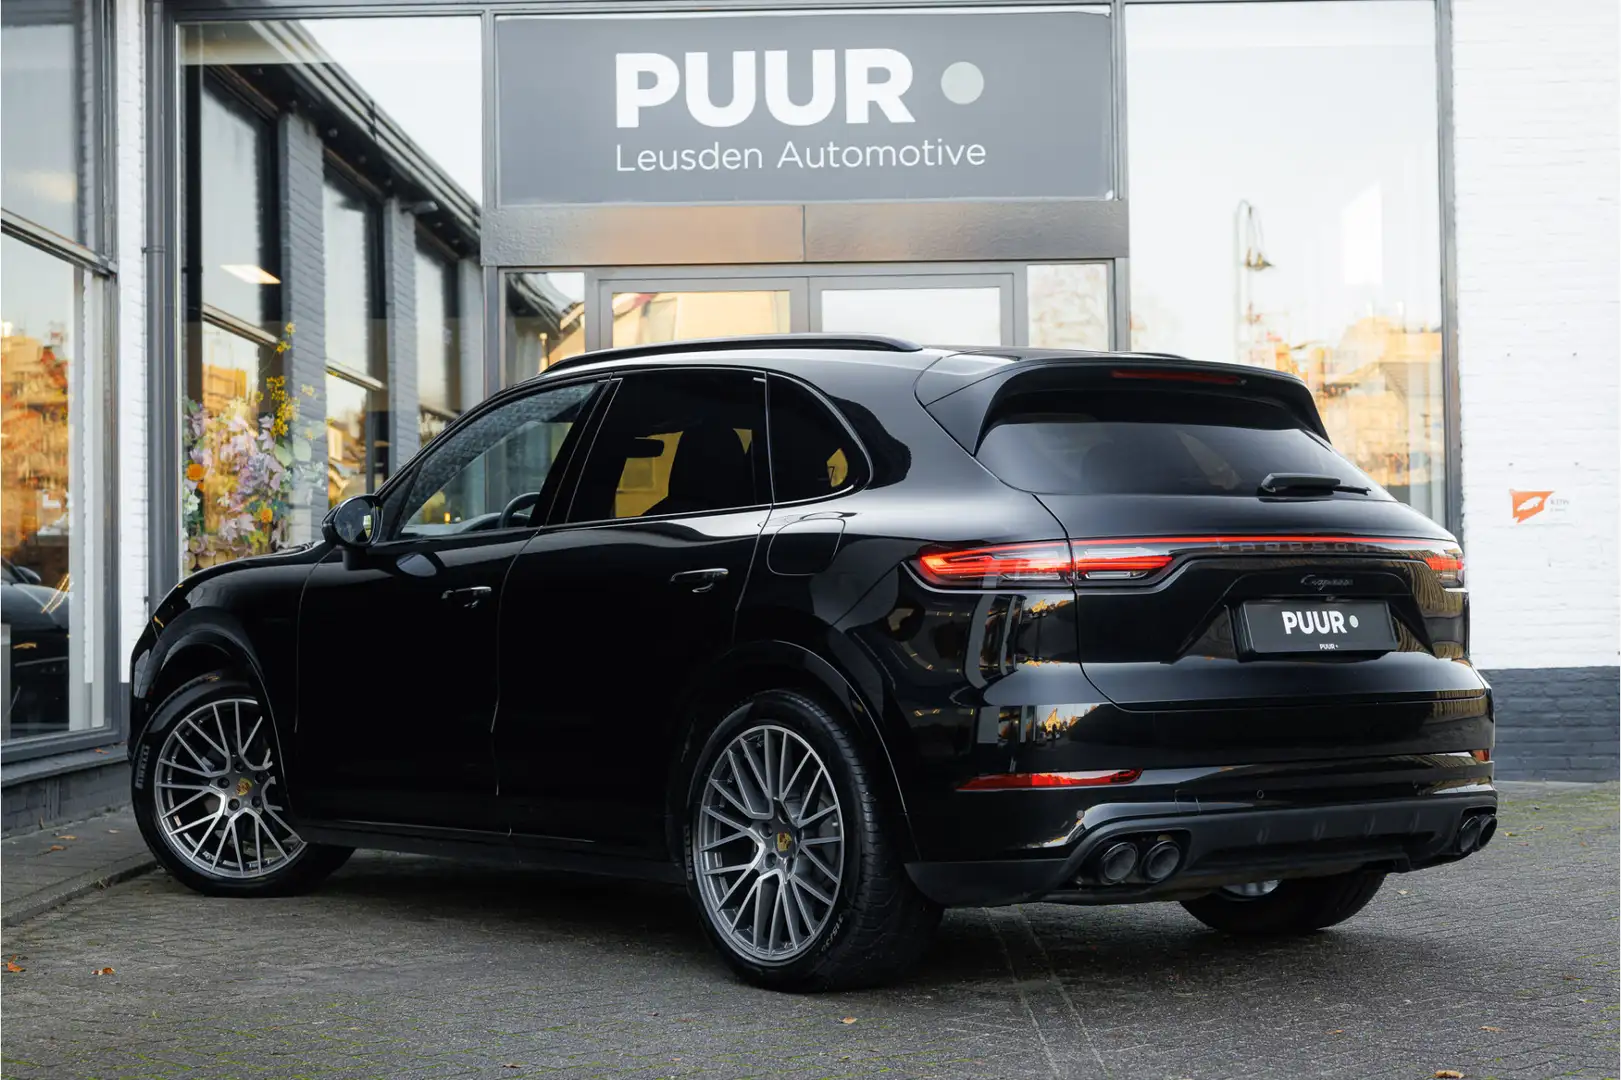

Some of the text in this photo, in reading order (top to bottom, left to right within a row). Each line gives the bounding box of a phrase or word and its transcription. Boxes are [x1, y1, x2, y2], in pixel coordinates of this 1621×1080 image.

[616, 48, 916, 128] PUUR
[616, 138, 987, 172] Leusden Automotive
[1281, 610, 1348, 635] PUUR
